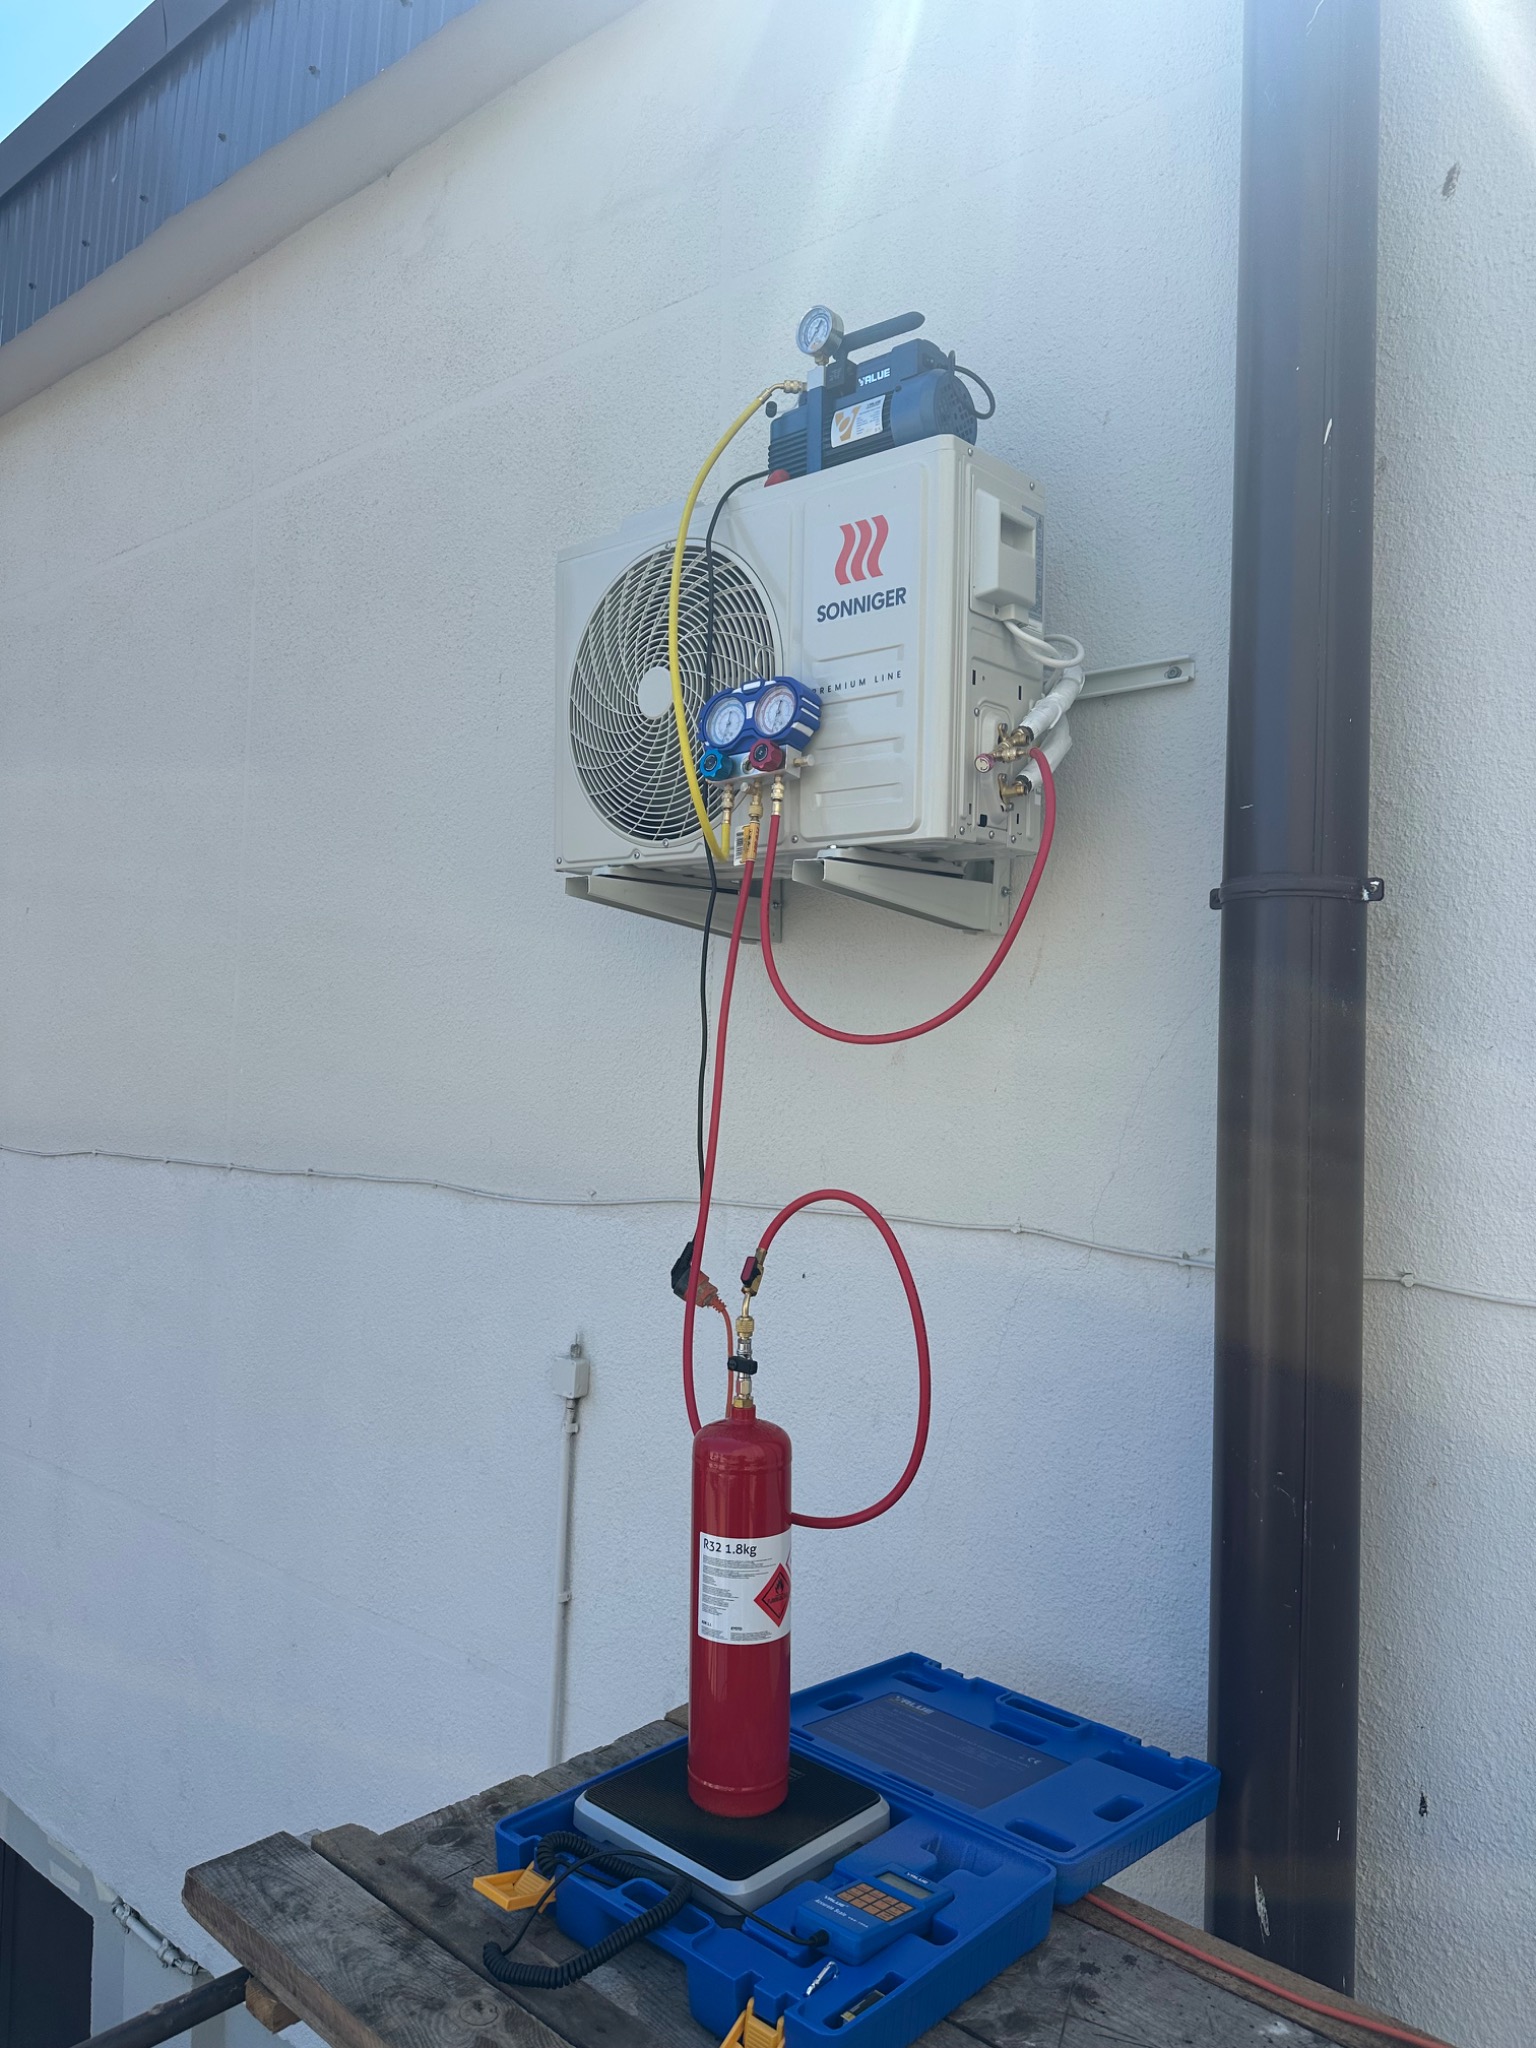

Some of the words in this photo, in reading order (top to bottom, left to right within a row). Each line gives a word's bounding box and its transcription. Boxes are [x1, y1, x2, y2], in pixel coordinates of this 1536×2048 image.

[858, 367, 891, 387] VALUE
[816, 586, 907, 623] SONNIGER
[874, 670, 902, 684] LINE
[703, 1537, 721, 1553] R32
[725, 1543, 757, 1558] 1.8kg
